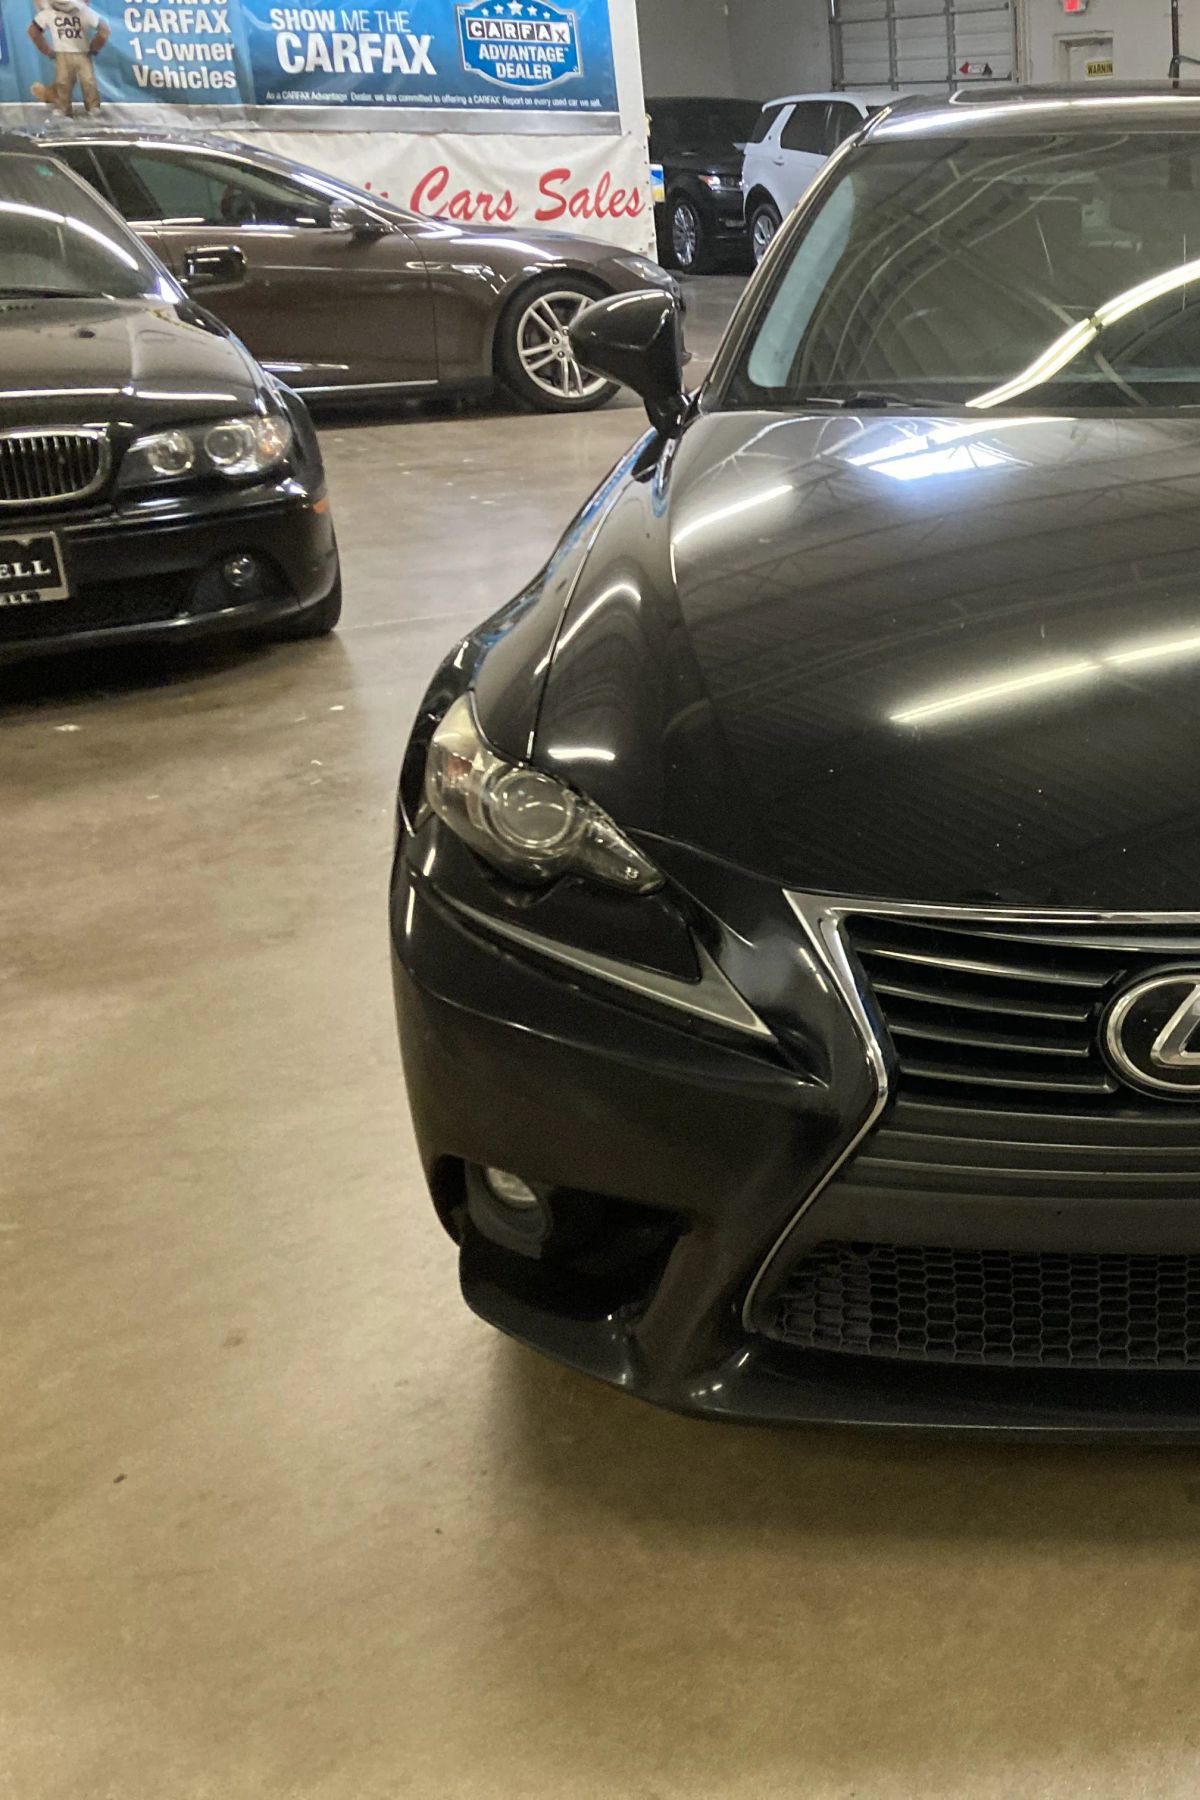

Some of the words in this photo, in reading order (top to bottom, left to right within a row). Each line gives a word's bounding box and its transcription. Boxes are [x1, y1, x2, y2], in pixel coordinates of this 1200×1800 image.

[54, 16, 82, 28] CAR
[123, 8, 232, 34] CARFAX
[270, 8, 336, 31] SHOW
[340, 9, 371, 31] ME
[374, 10, 412, 33] THE
[469, 20, 568, 42] CARFAX
[58, 28, 83, 40] FOX
[129, 37, 235, 62] 1-Owner
[276, 32, 437, 75] CARFAX
[479, 44, 565, 63] ADVANTAGE
[132, 64, 238, 89] Vehicles
[495, 62, 553, 80] DEALER
[281, 91, 310, 100] CARFAX
[409, 165, 520, 222] Cars
[534, 167, 647, 222] Sales
